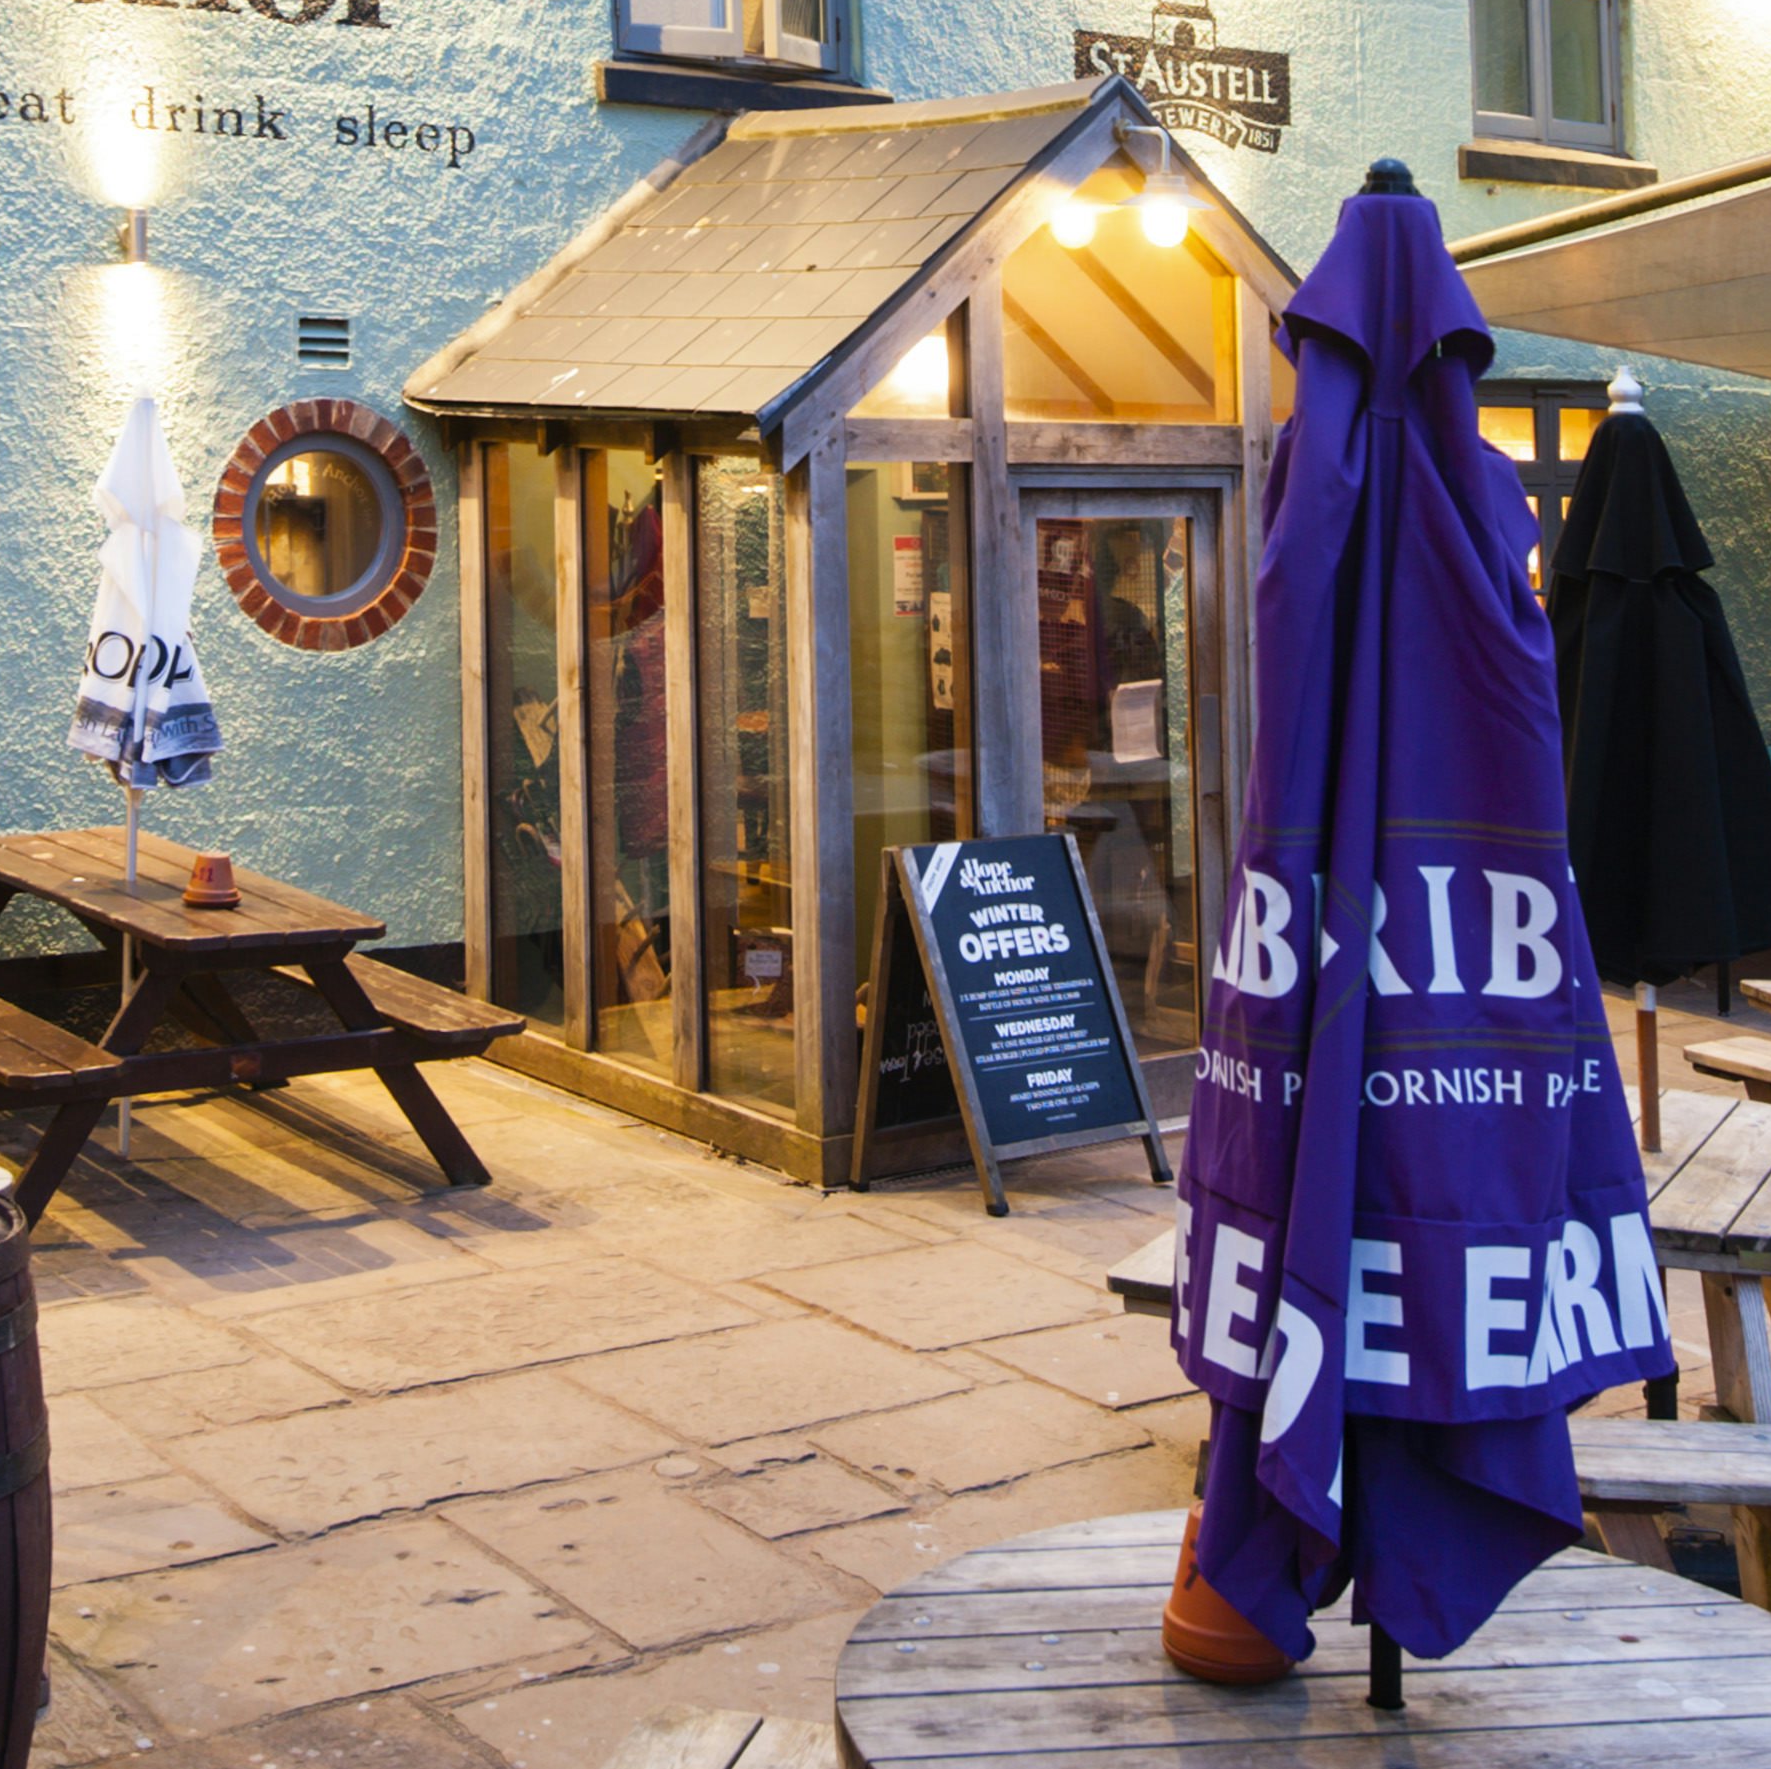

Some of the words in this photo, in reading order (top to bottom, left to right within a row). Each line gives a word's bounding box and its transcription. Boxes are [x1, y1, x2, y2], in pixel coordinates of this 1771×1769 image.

[1136, 48, 1279, 105] AUSTELL
[130, 84, 288, 143] drink
[334, 103, 478, 169] sleep
[1151, 107, 1237, 143] REWERY
[959, 867, 978, 889] &
[973, 875, 1036, 896] Anchor
[963, 857, 1013, 881] Hope
[969, 903, 1045, 929] WINTER
[959, 923, 1070, 963] OFFERS
[993, 966, 1050, 986] MONDAY
[994, 1014, 1076, 1038] WEDNESDAY
[1026, 1067, 1073, 1089] FRIDAY
[1359, 1067, 1524, 1108] ORNISH
